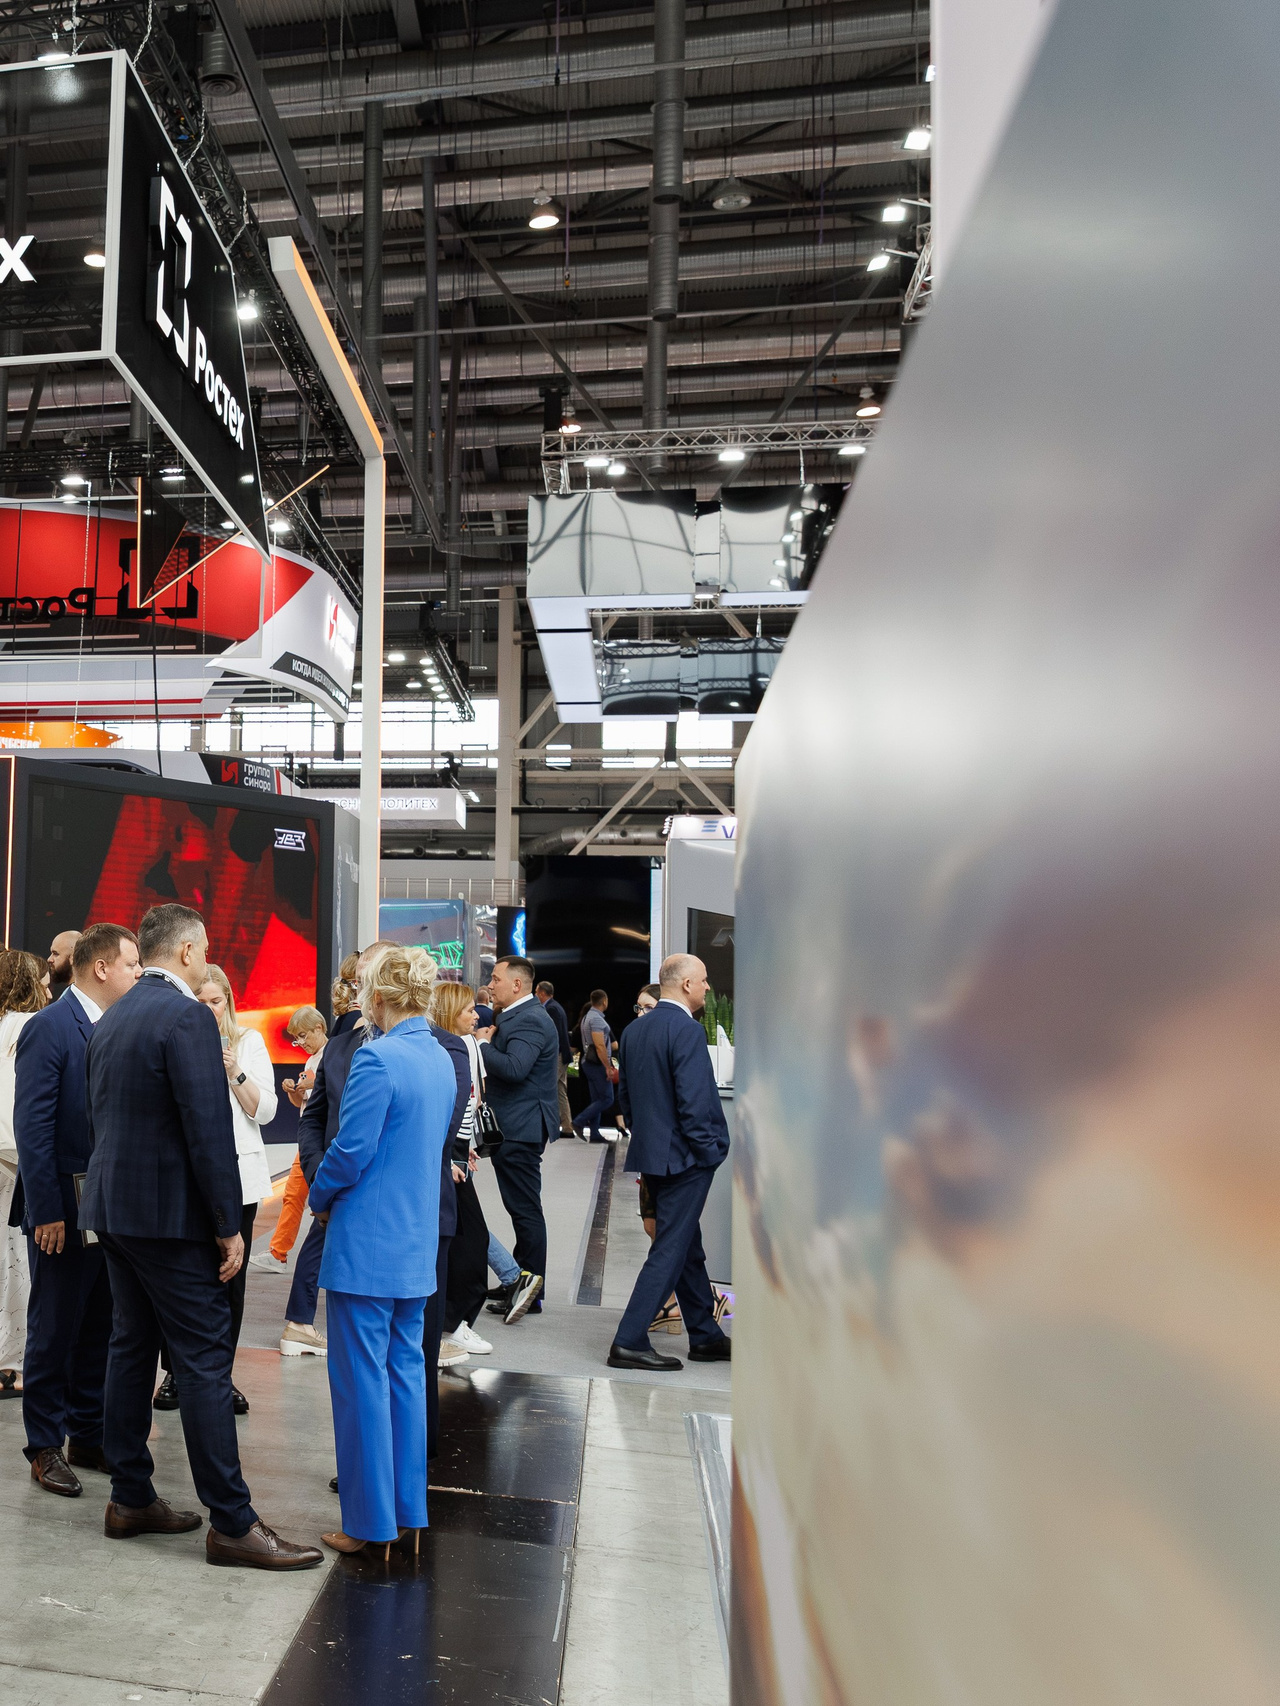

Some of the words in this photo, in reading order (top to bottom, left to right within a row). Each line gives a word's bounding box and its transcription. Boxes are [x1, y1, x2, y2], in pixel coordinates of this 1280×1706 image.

[194, 326, 245, 451] Ростех
[292, 658, 312, 677] КОГДА
[243, 763, 270, 778] группа
[243, 776, 271, 792] синара
